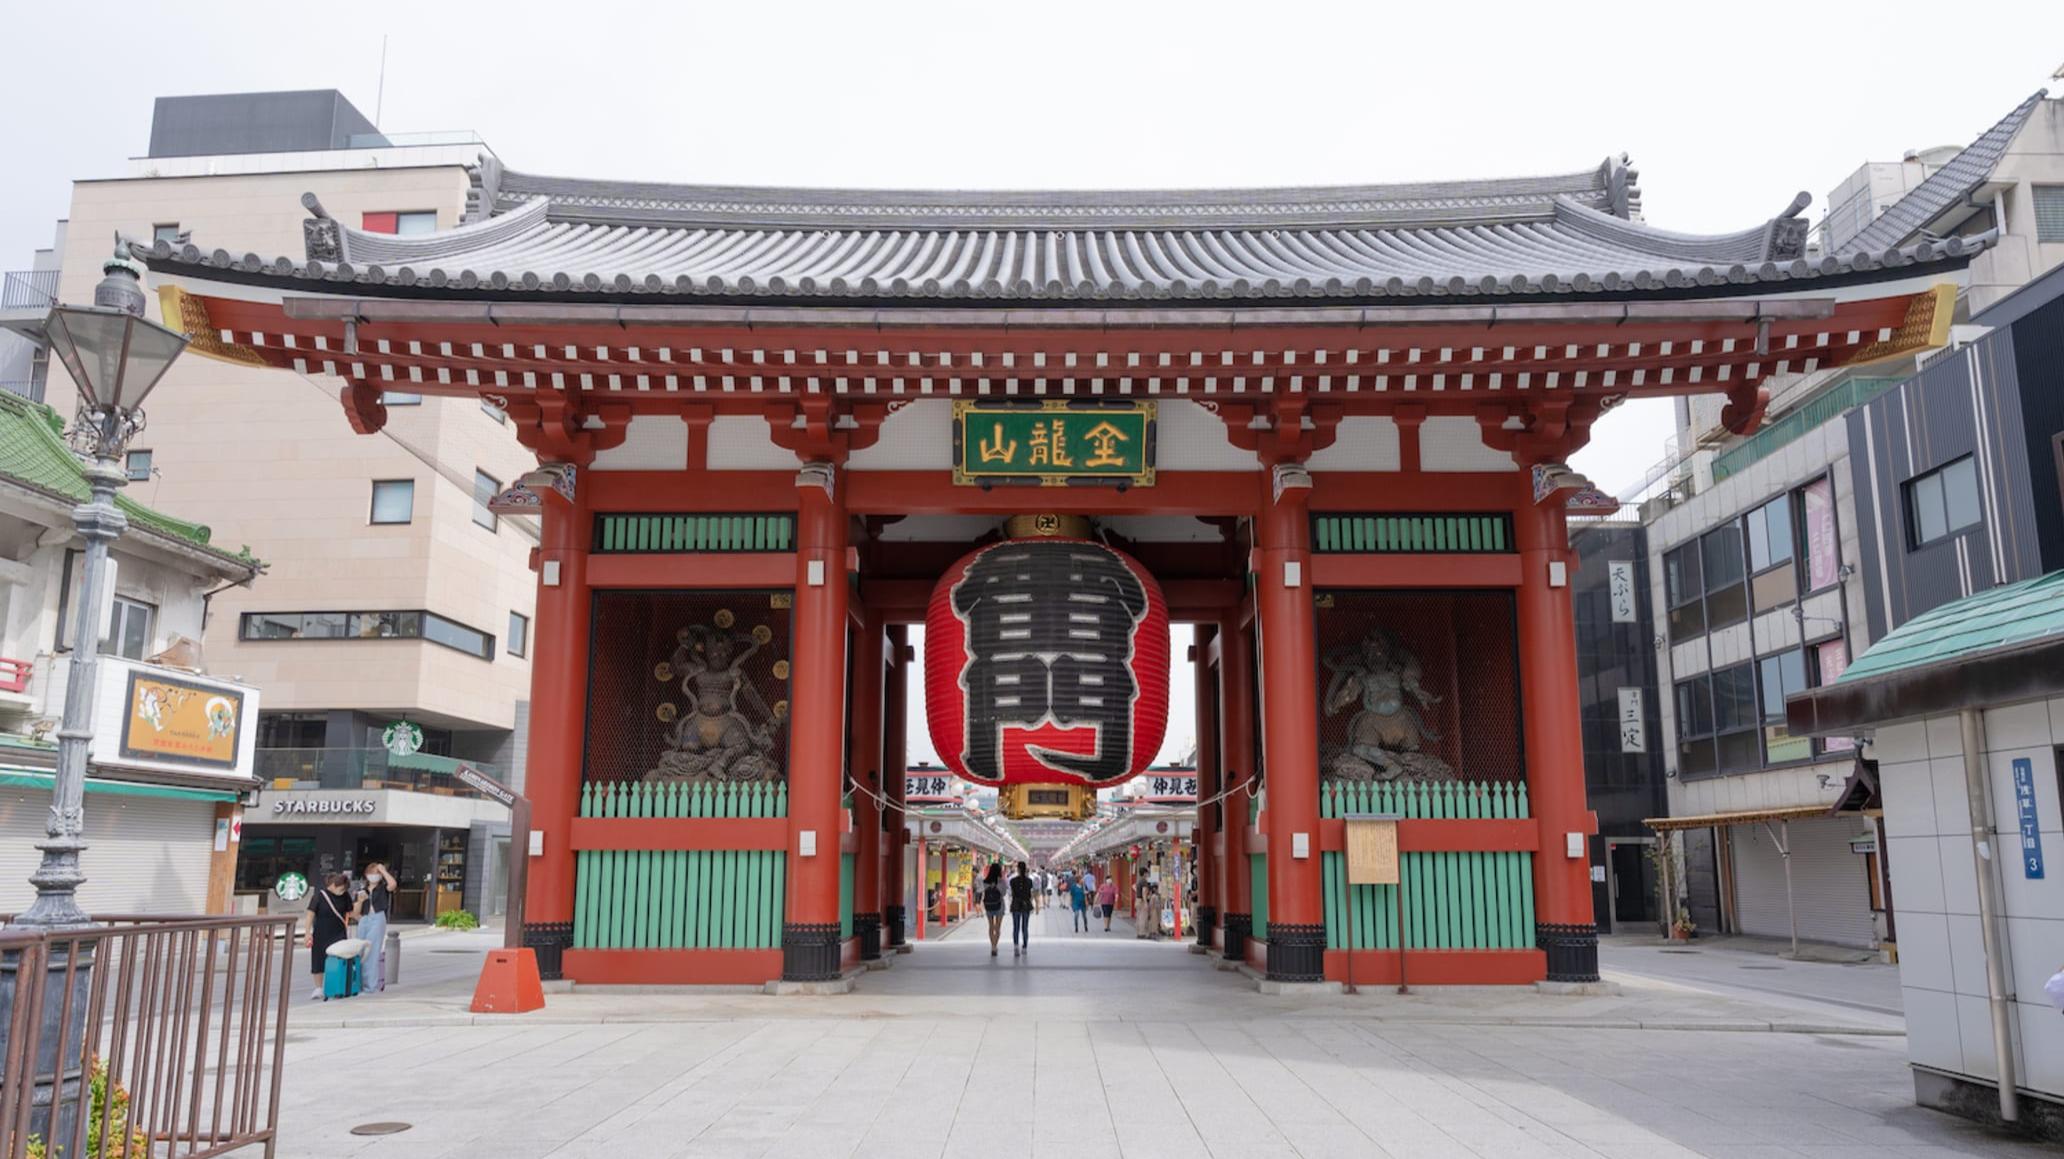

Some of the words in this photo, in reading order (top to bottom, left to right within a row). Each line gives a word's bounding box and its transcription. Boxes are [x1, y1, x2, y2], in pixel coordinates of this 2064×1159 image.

[980, 419, 1129, 467] 金龍山
[1622, 709, 1641, 748] 三定
[274, 800, 376, 814] STARBUCKS
[2029, 857, 2038, 871] 3
